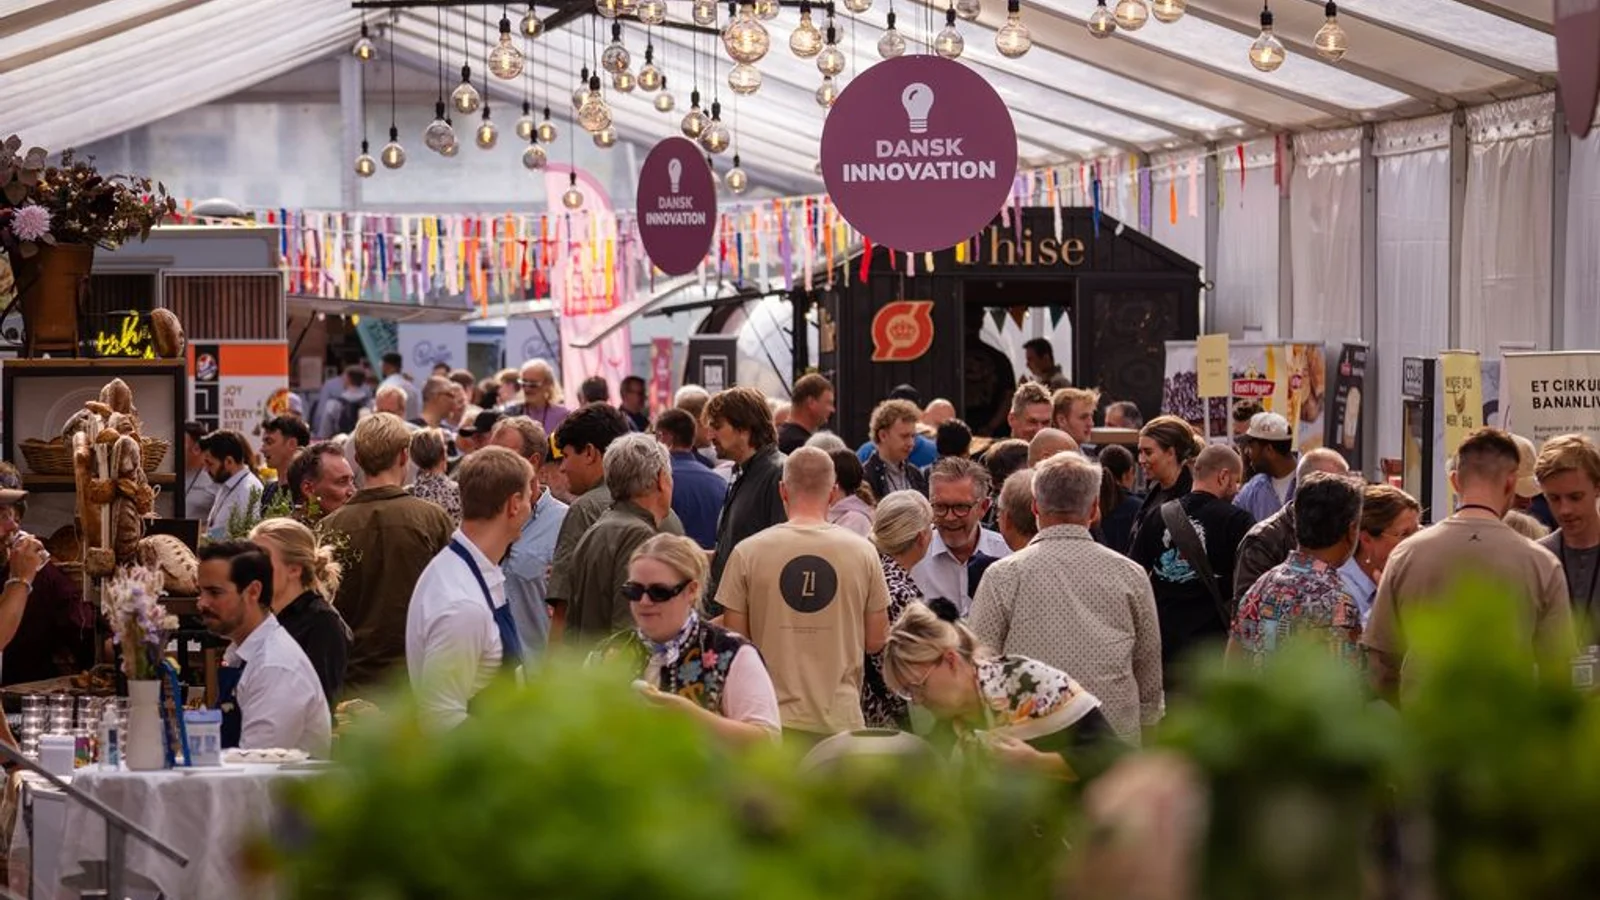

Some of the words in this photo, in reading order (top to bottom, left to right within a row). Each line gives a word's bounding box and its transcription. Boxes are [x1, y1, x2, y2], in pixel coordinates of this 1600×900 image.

[876, 138, 963, 157] DANSK
[843, 161, 996, 182] INNOVATION
[658, 196, 694, 208] DANSK
[645, 212, 706, 226] INNOVATION
[962, 225, 1085, 266] hise
[224, 386, 242, 395] JOY
[1531, 380, 1549, 393] ET
[224, 398, 234, 407] IN
[224, 409, 253, 419] EVERY
